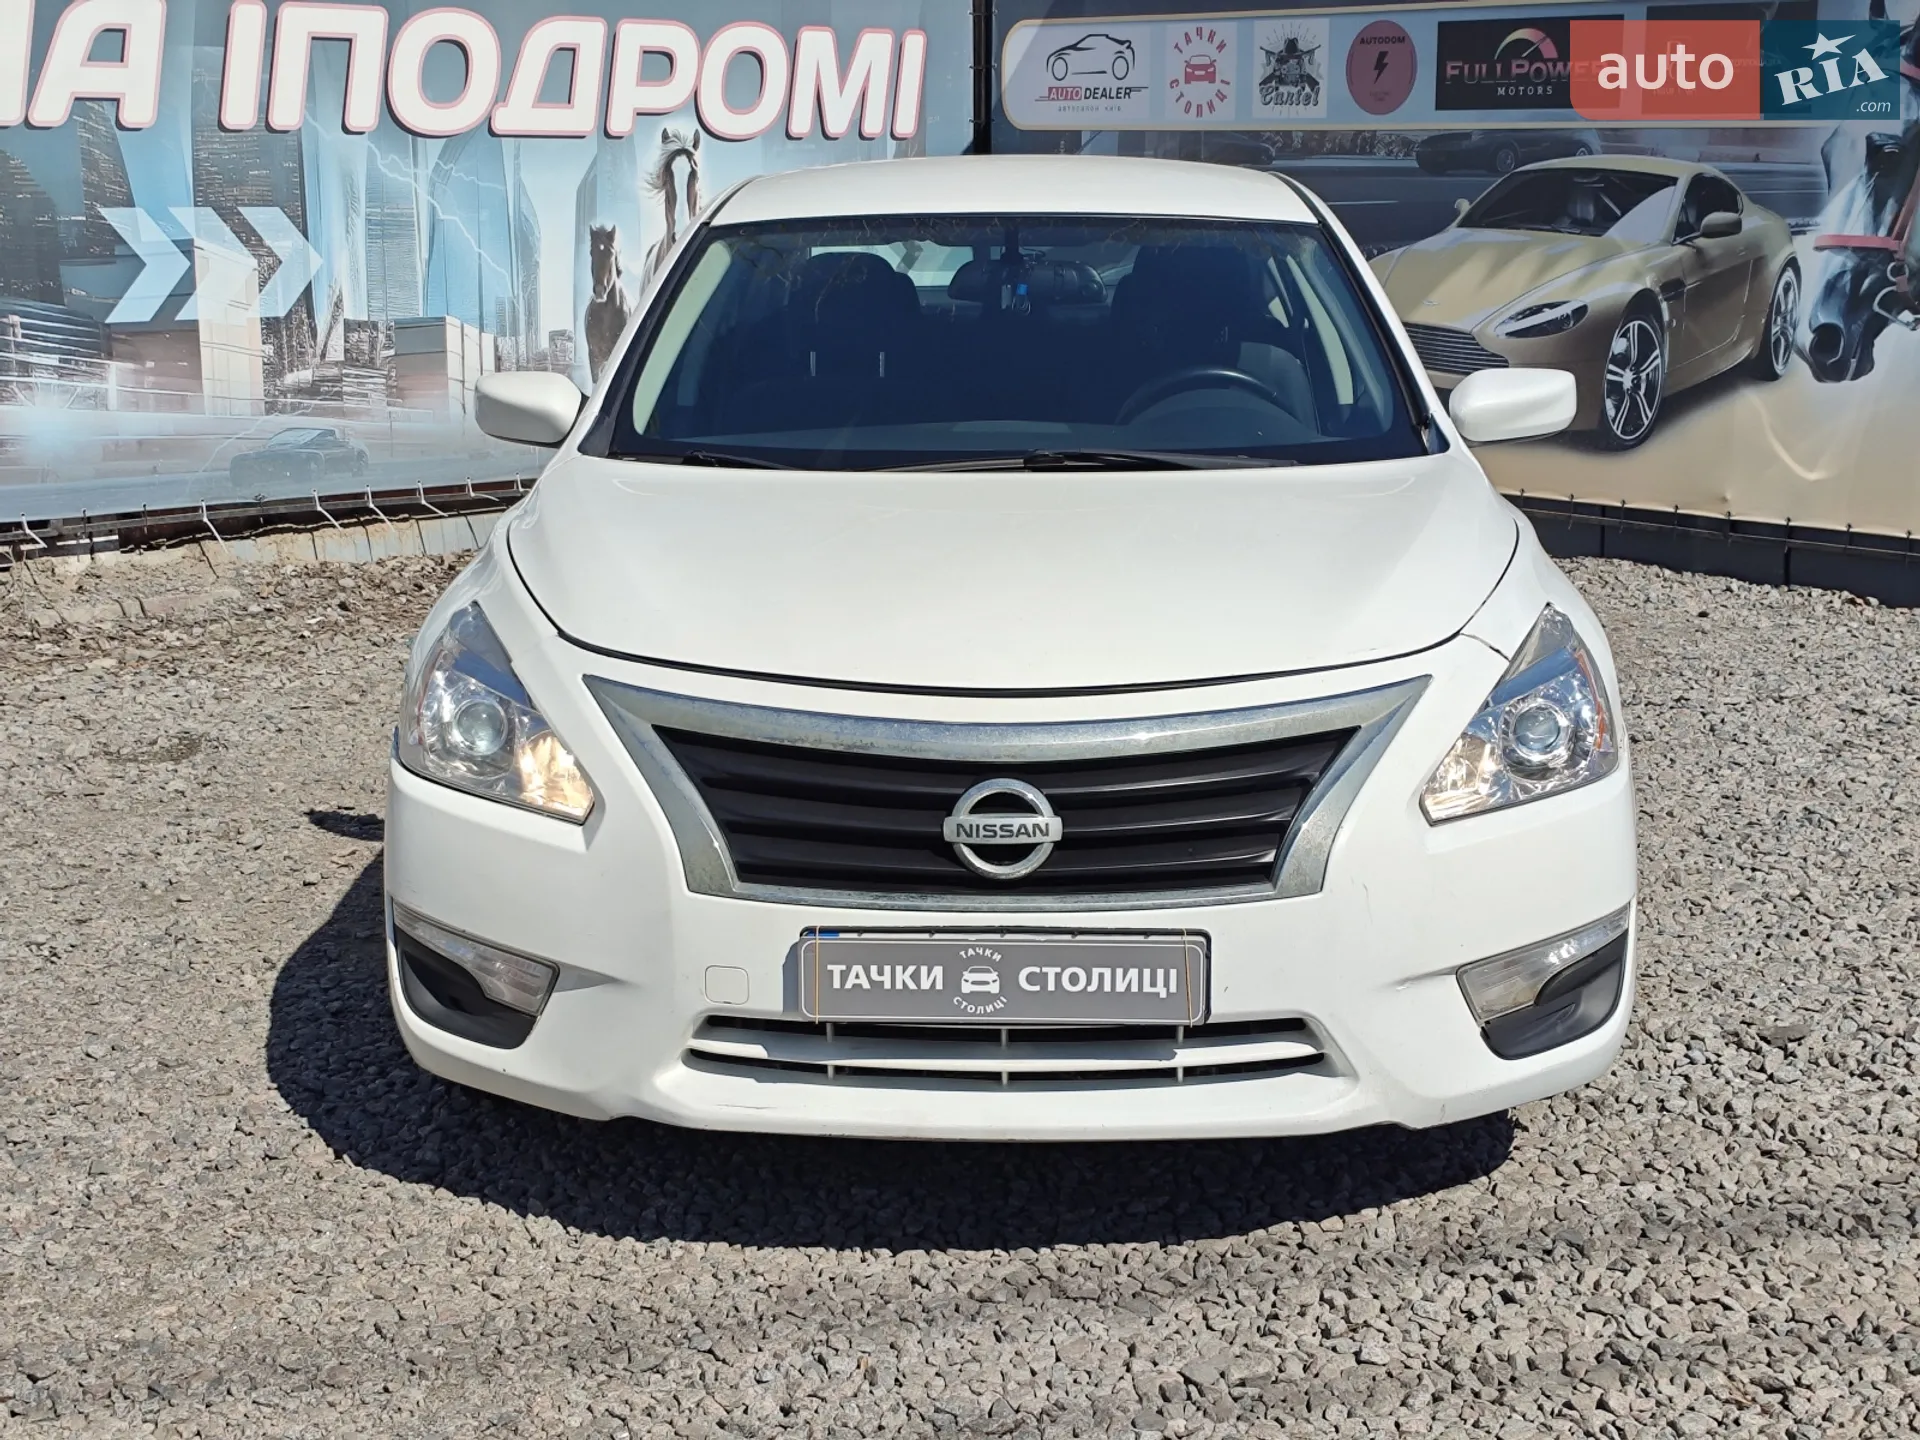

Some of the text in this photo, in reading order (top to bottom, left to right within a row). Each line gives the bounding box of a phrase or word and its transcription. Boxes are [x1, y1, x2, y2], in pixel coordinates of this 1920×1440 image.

[1174, 27, 1226, 54] ТАЧКИ
[1360, 36, 1405, 45] AUTODOM
[219, 0, 926, 139] ІПОДРОМІ
[1049, 87, 1132, 100] AUTO DEALER
[1170, 79, 1230, 117] СТОЛИЦІ
[1259, 86, 1320, 107] Cartel
[1498, 85, 1553, 96] MOTORS
[956, 823, 1050, 838] NISSAN
[959, 947, 1002, 962] ТАЧКИ
[827, 965, 1178, 998] ТАЧКИ СТОЛИЦІ
[953, 996, 1008, 1014] СТОЛИЦІ
